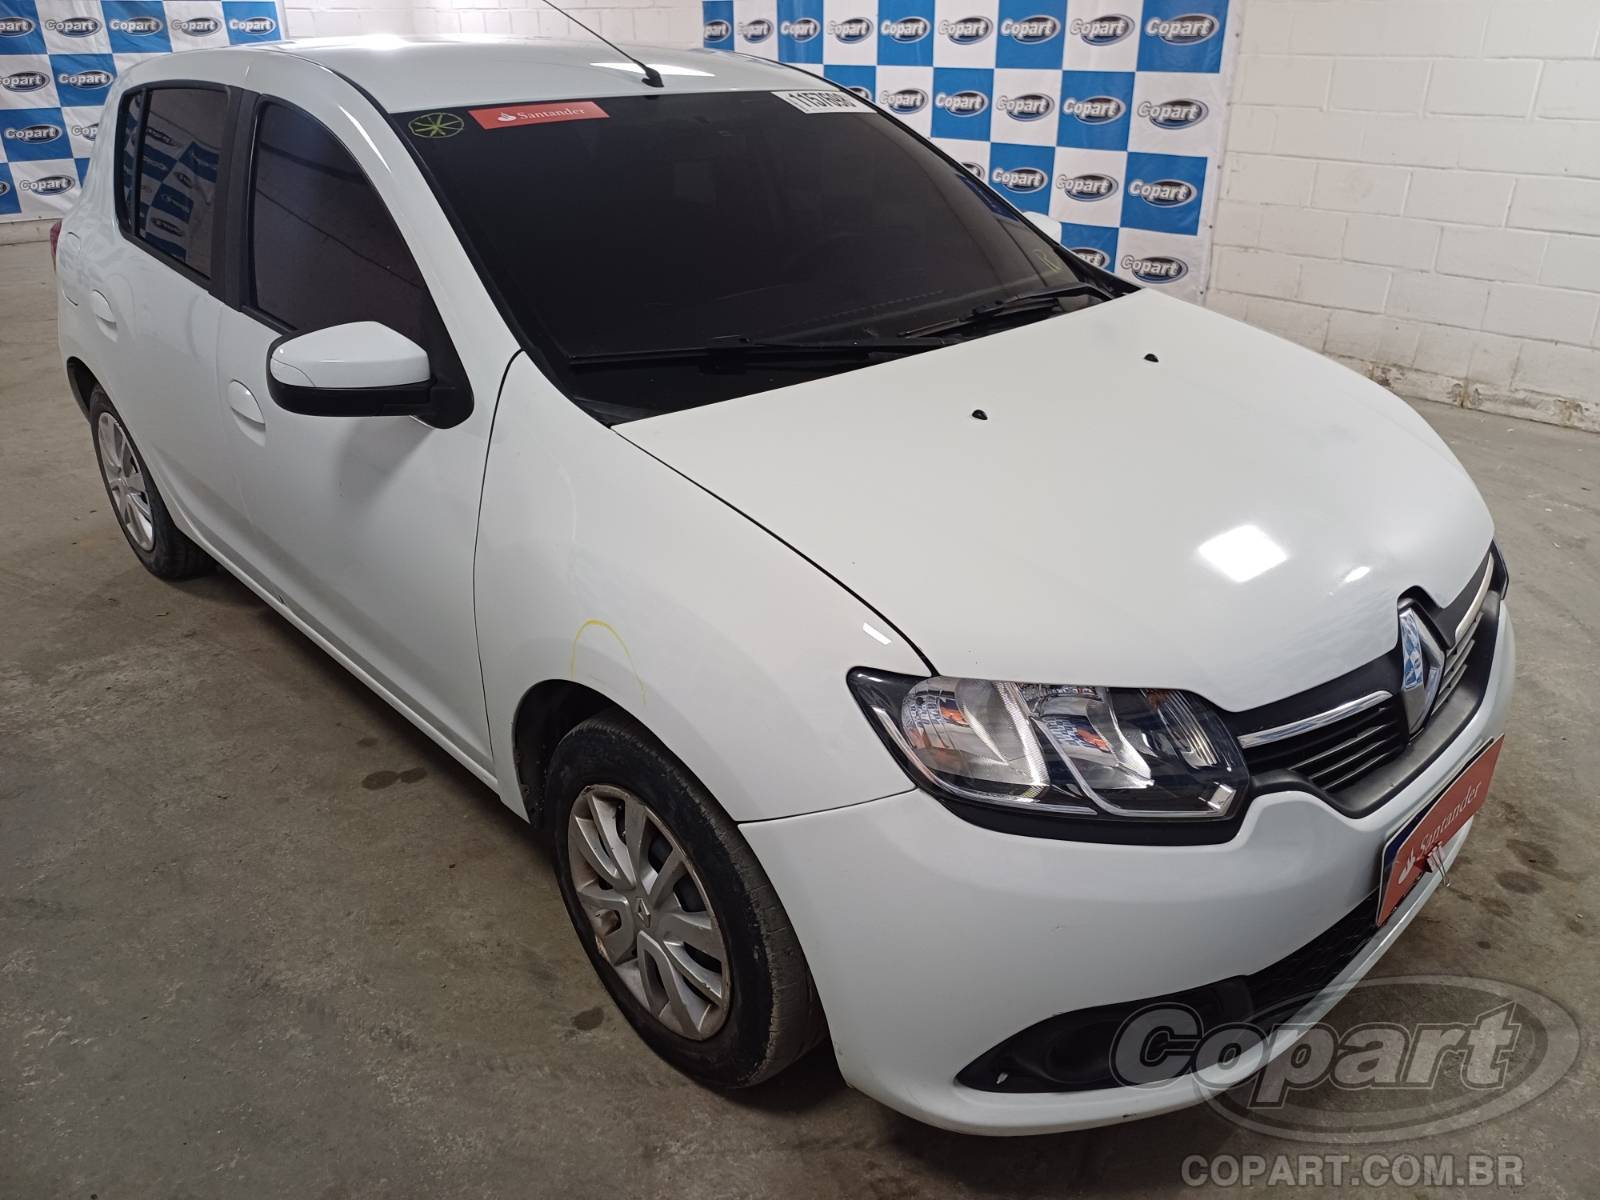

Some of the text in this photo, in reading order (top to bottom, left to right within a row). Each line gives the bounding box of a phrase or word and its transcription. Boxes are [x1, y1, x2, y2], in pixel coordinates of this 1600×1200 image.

[0, 20, 28, 33] part
[45, 19, 95, 33] Copart
[109, 19, 157, 33] Copart
[170, 19, 216, 33] Copart
[229, 18, 271, 32] Copart
[704, 22, 727, 39] part
[827, 20, 866, 39] Copart
[881, 20, 924, 38] Copart
[938, 19, 987, 39] Copart
[1001, 18, 1052, 39] Copart
[1070, 18, 1125, 39] Copart
[1146, 16, 1211, 40] Copart
[0, 75, 41, 88] opart
[58, 73, 107, 87] Copart
[880, 89, 922, 109] Copart
[935, 92, 982, 109] Copart
[996, 95, 1047, 115] Copart
[1063, 97, 1117, 117] Copart
[517, 107, 585, 120] Santander
[1137, 101, 1199, 122] Copart
[4, 127, 56, 141] Copart
[71, 125, 98, 138] Cop
[20, 178, 68, 193] Copart
[992, 167, 1041, 187] Copart
[1056, 174, 1110, 195] Copart
[1129, 180, 1190, 201] Copart
[1121, 255, 1179, 278] Copart
[1420, 781, 1482, 854] Santander
